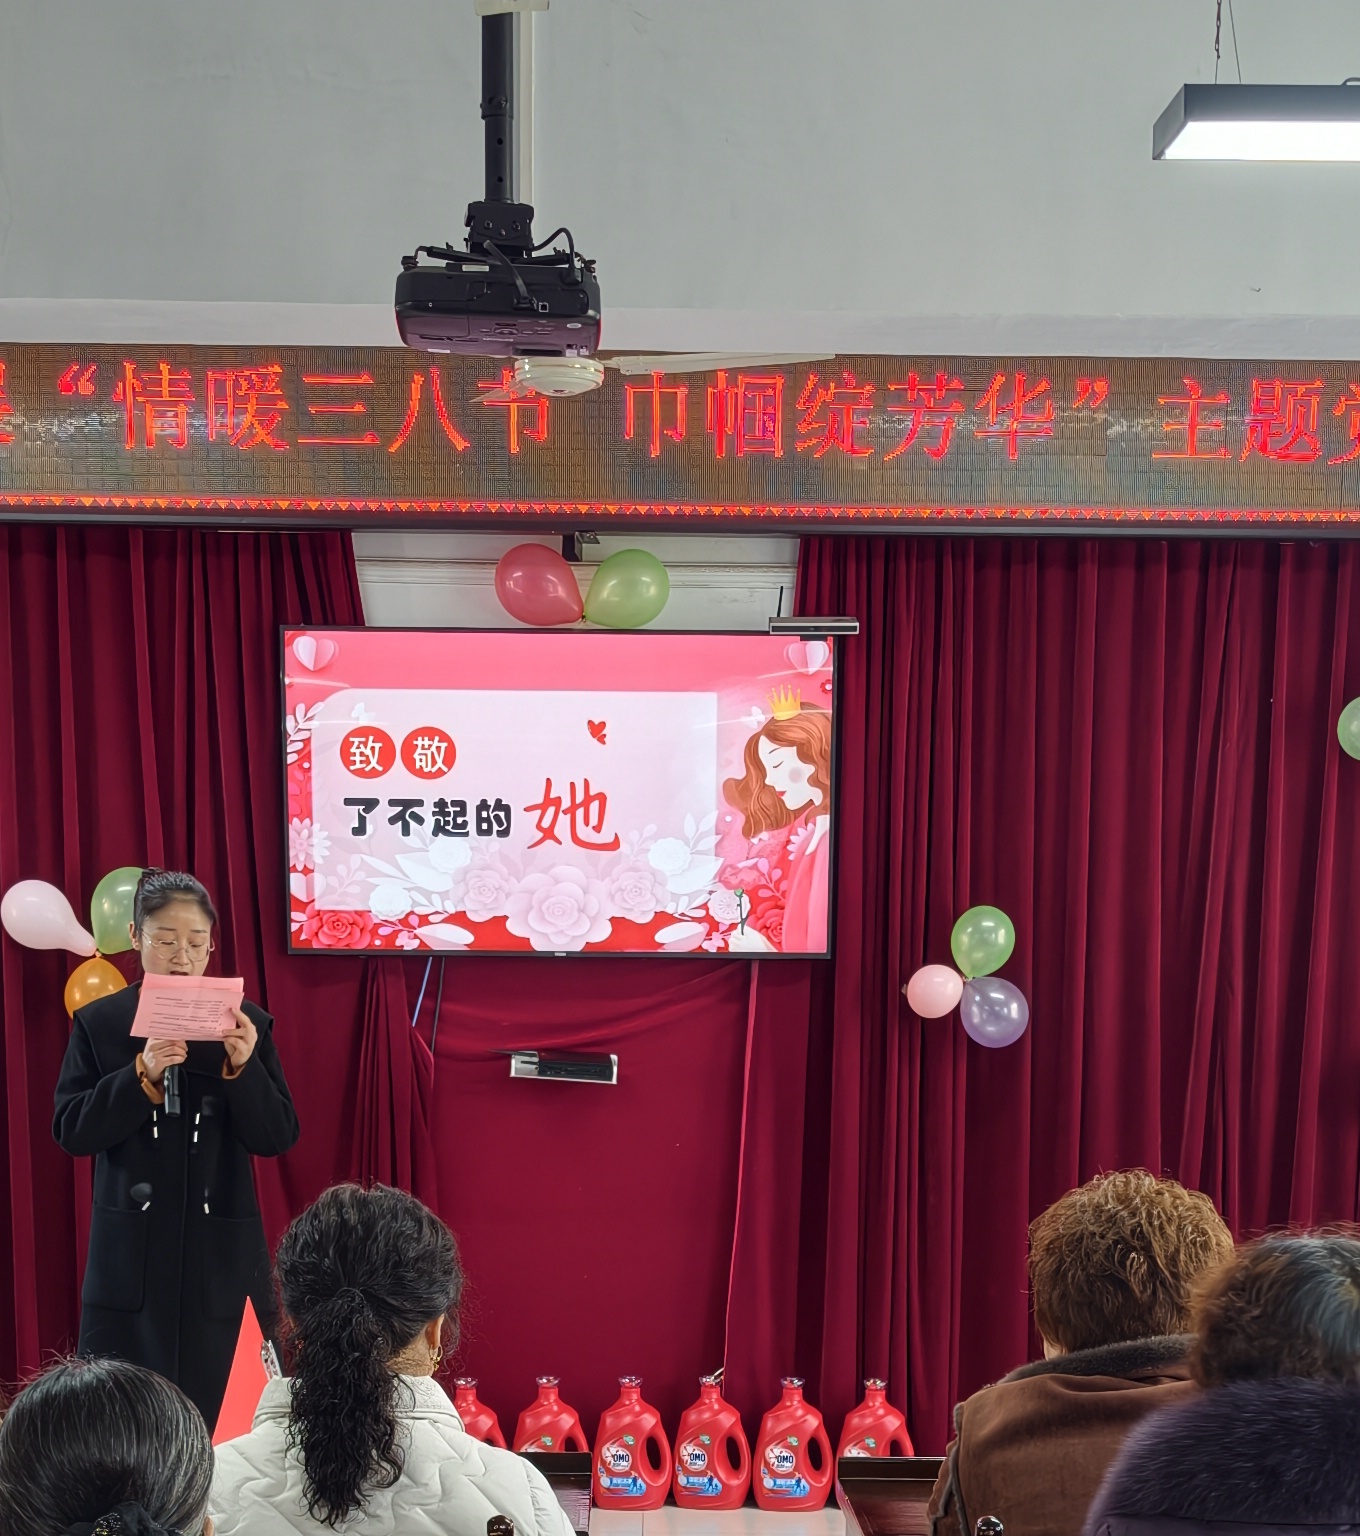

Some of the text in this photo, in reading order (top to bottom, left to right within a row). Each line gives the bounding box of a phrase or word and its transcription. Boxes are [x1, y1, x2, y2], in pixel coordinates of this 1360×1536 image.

[348, 735, 449, 774] 致敬
[613, 1453, 630, 1463] OMO
[690, 1452, 706, 1462] OMO
[777, 1454, 794, 1464] OMO
